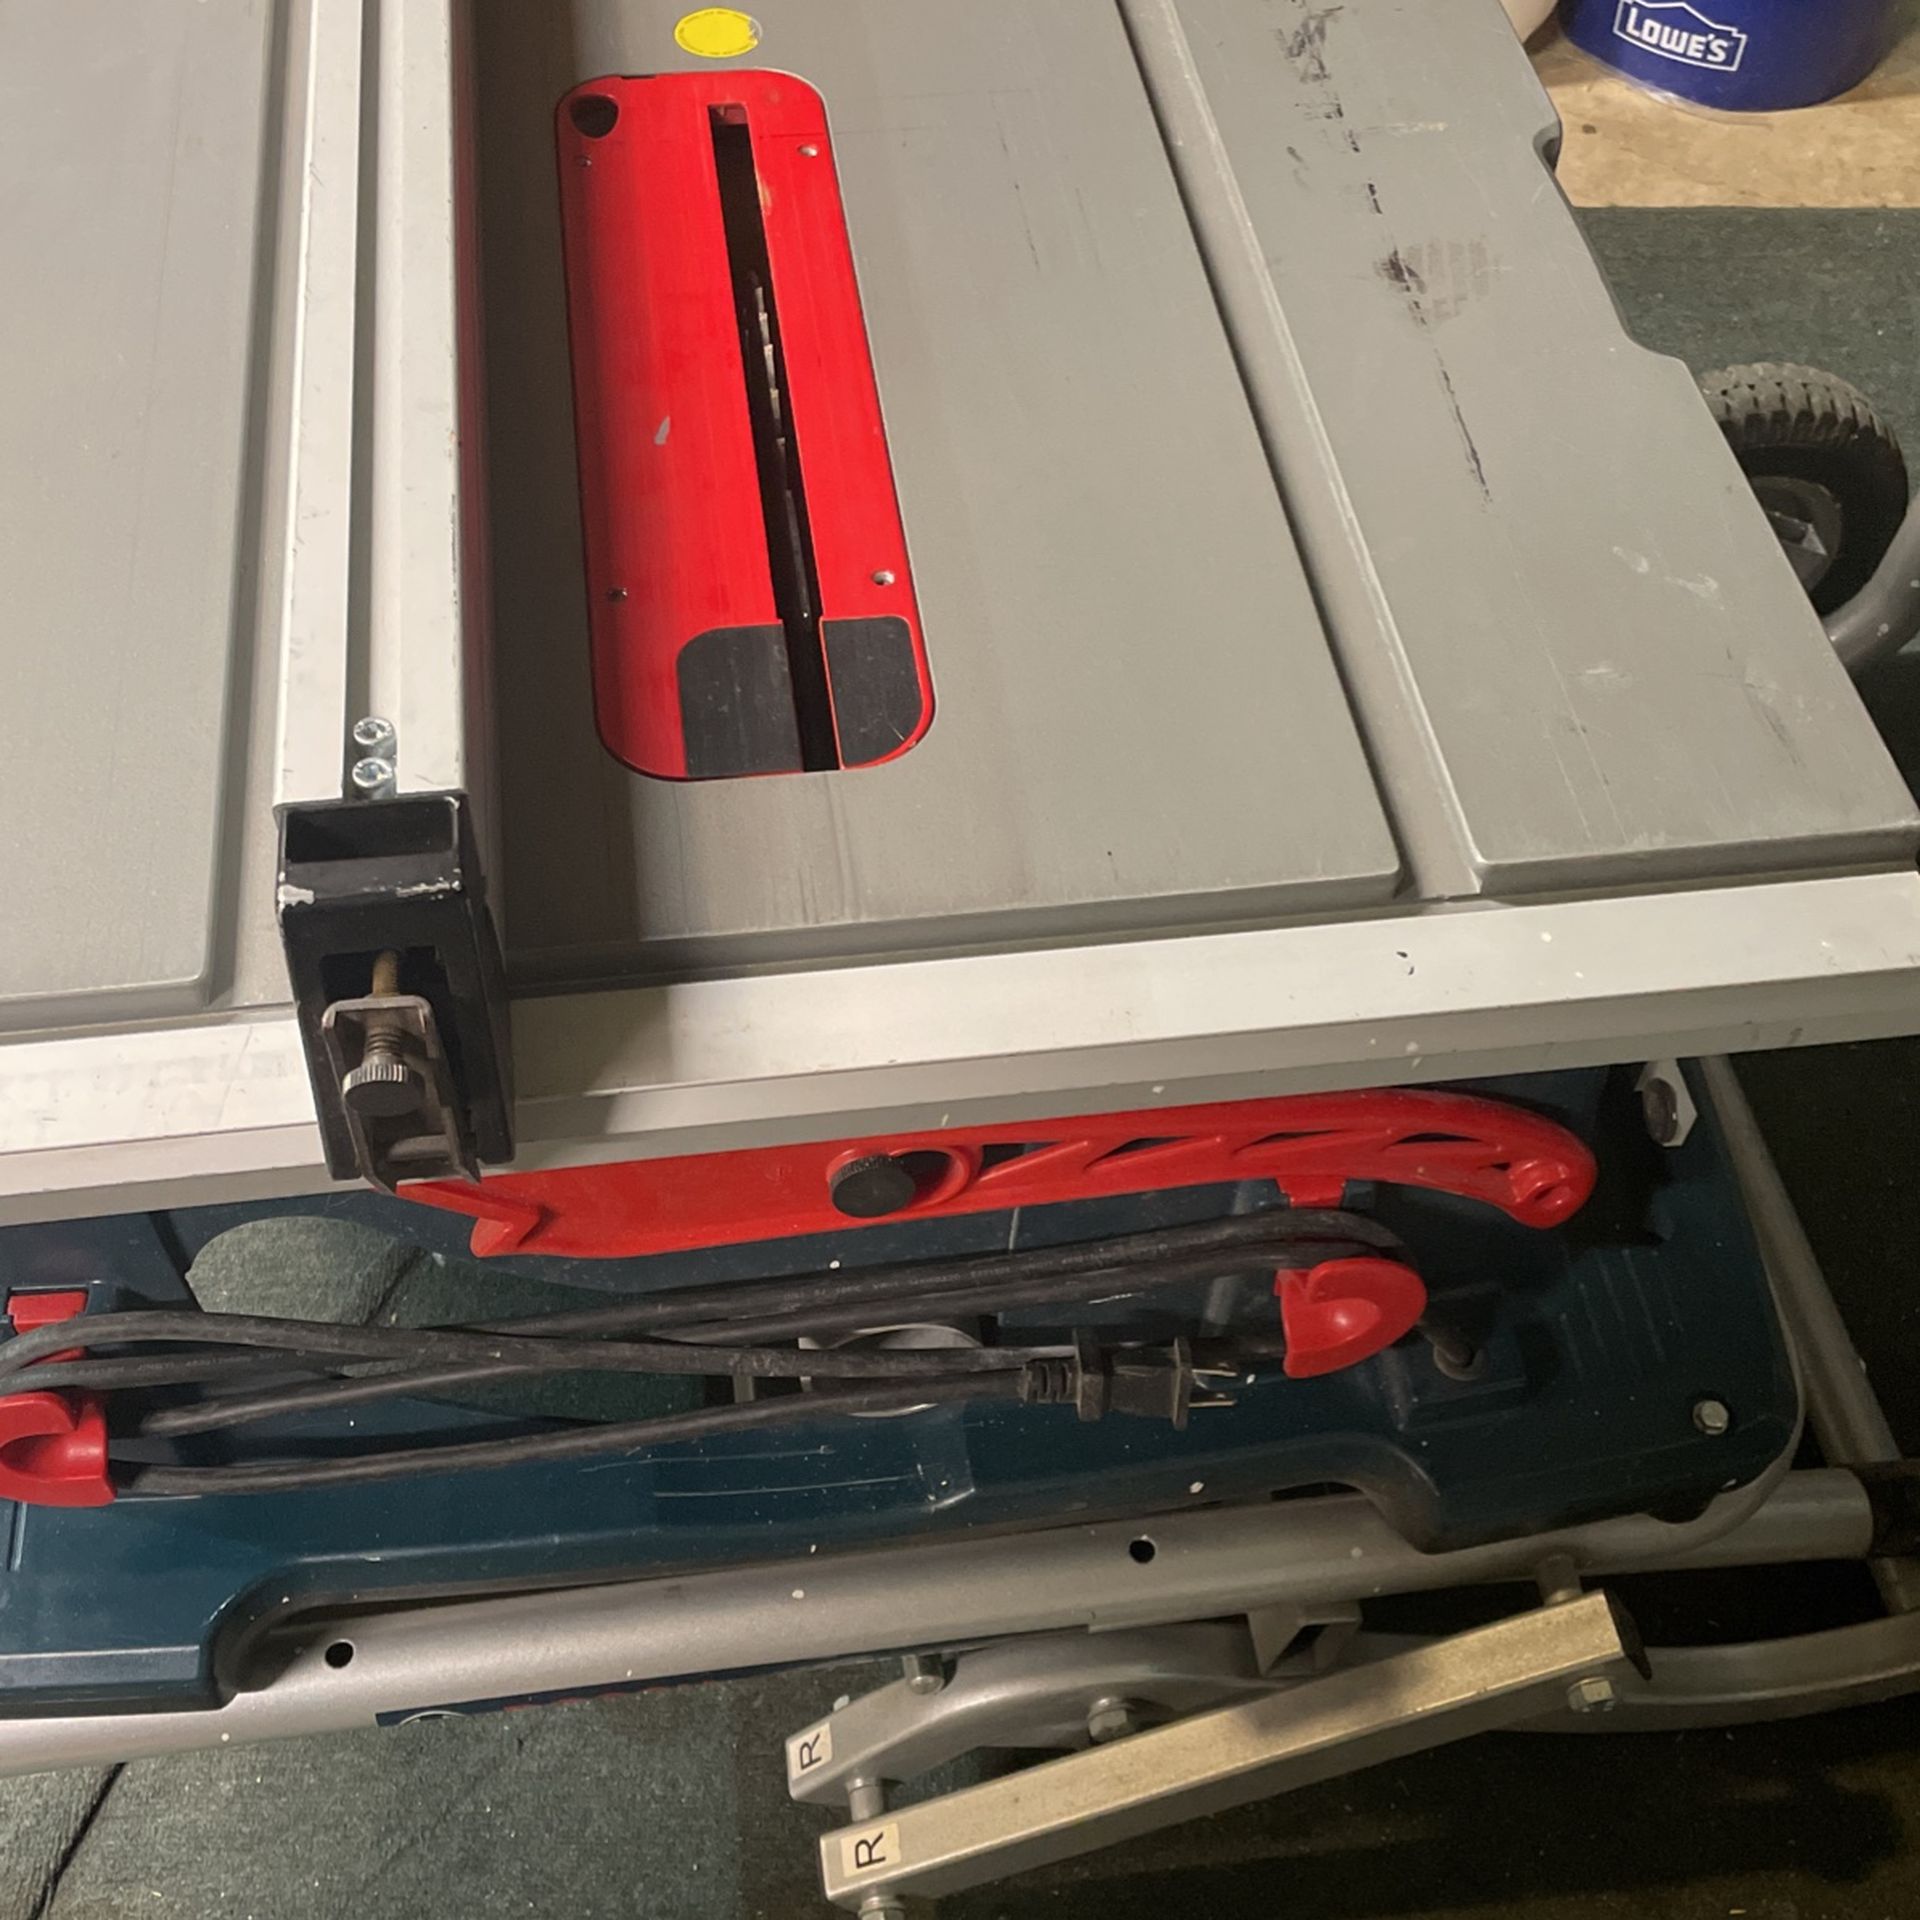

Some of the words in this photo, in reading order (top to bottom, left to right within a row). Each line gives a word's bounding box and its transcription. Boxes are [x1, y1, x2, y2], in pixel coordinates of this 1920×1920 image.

[1626, 7, 1729, 62] LOWE'S
[800, 1733, 822, 1770] R
[855, 1832, 886, 1869] R
